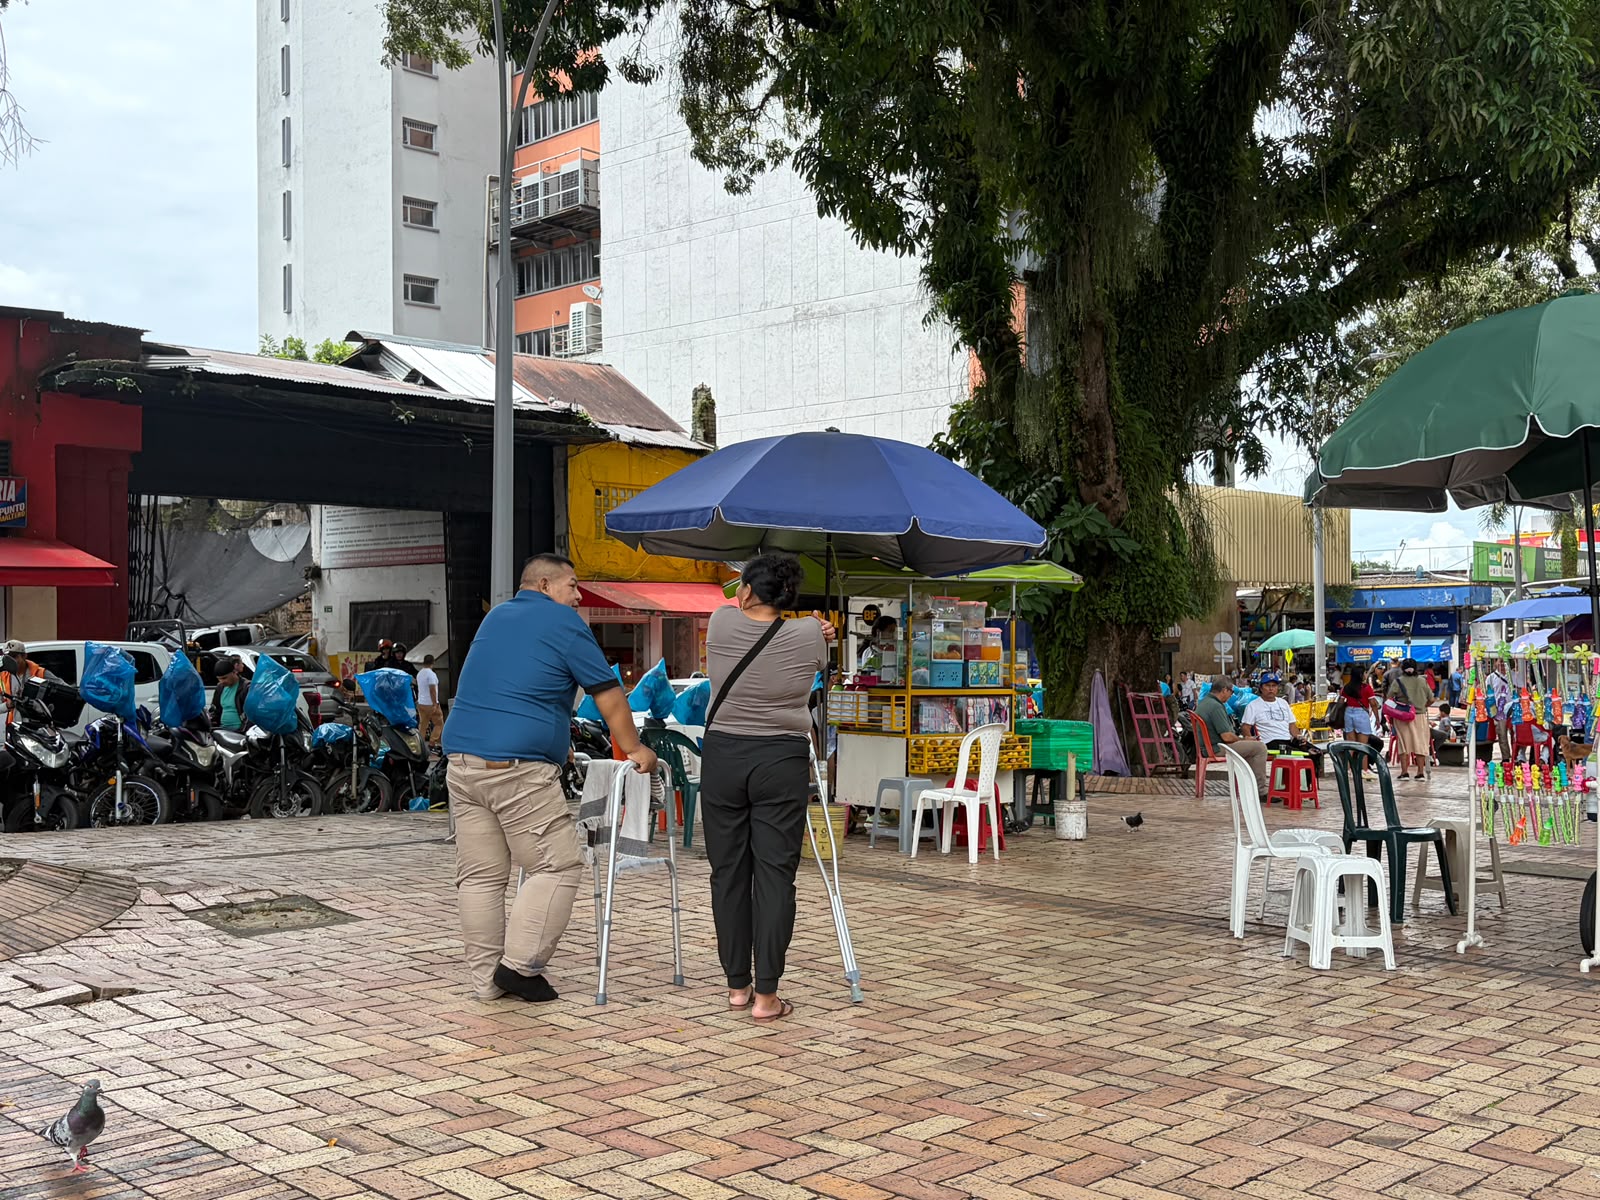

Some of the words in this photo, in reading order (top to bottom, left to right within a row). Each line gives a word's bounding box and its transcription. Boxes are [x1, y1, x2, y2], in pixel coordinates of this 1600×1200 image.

[1503, 551, 1513, 569] 20
[863, 609, 877, 621] BF
[1380, 622, 1403, 630] BetPlay
